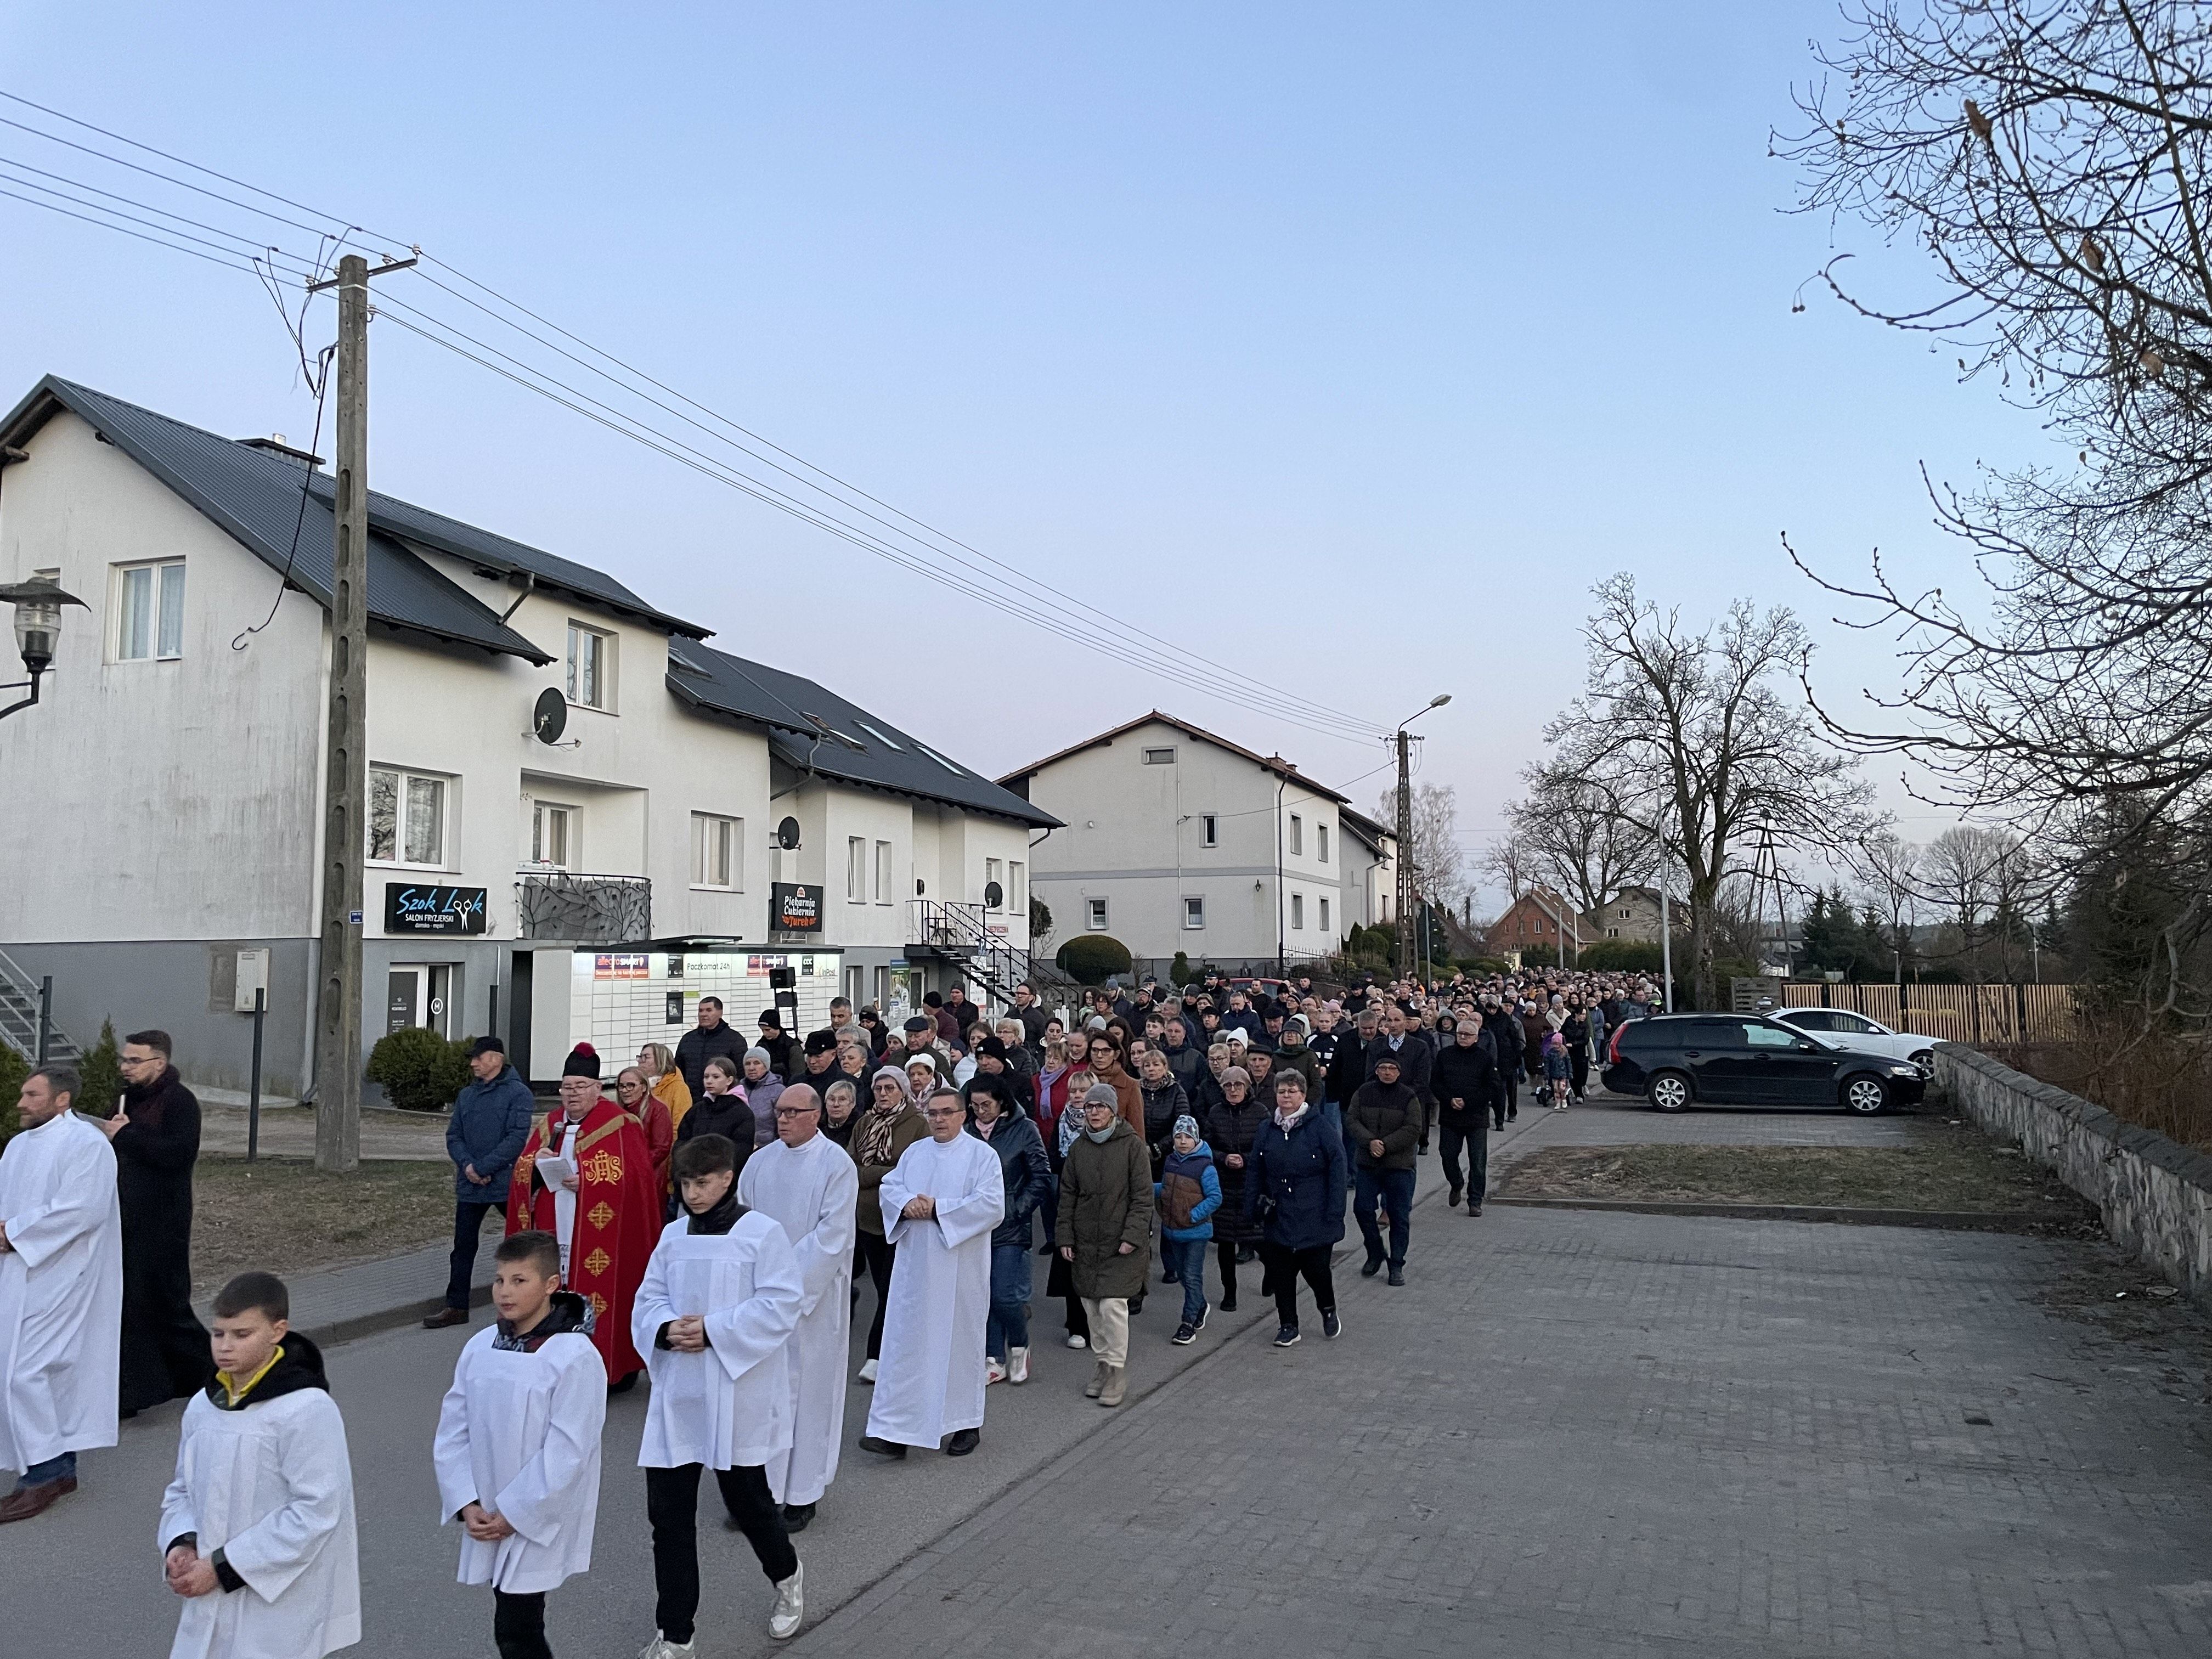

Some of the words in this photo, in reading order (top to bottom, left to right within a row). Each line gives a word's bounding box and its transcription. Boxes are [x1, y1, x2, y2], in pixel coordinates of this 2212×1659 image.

[396, 888, 437, 915] Szok
[784, 895, 815, 907] Piekarnia
[784, 905, 815, 917] Cukiernia
[405, 913, 424, 922] SALON
